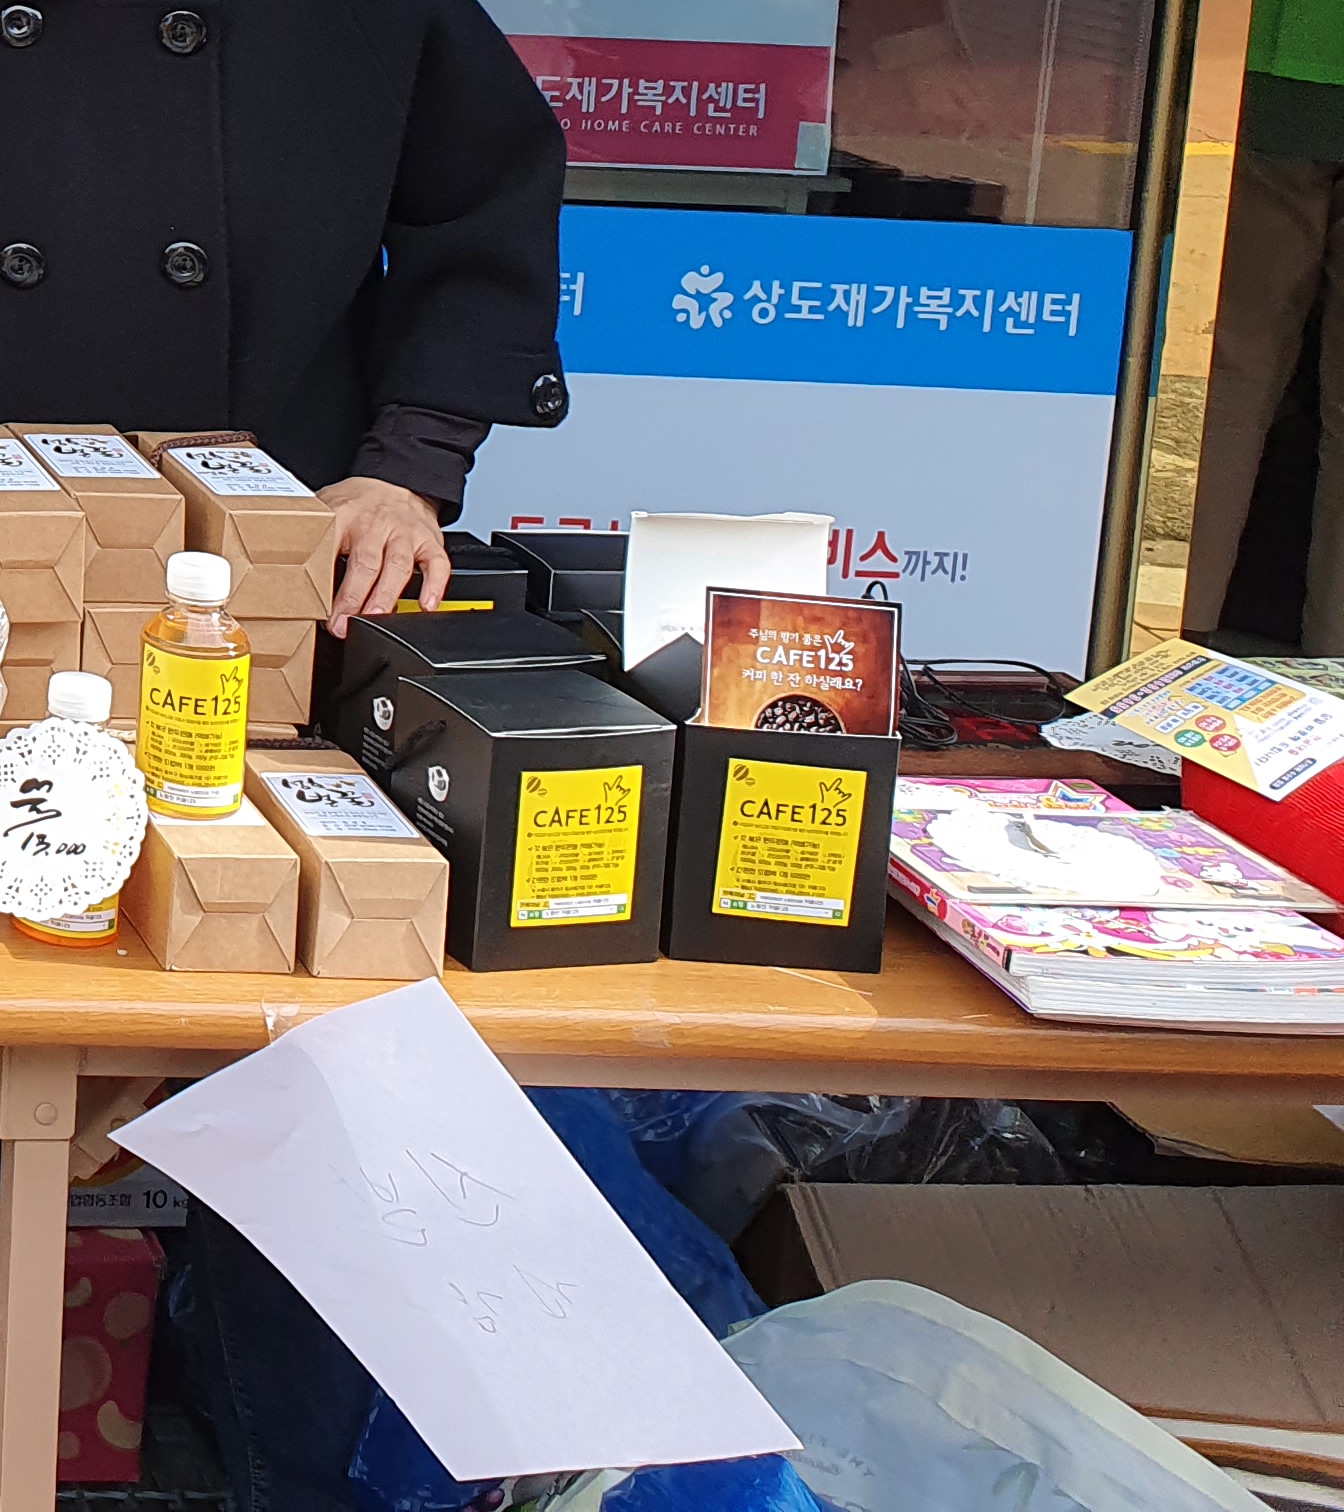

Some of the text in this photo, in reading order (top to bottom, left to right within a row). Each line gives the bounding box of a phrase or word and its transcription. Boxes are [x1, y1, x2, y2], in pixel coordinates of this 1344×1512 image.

[581, 118, 760, 138] HOME CARE CENTER
[743, 278, 1082, 338] 상도재가복지센터
[756, 645, 853, 672] CAFE125
[742, 668, 862, 691] 커피 한 잔 하실래요?
[534, 804, 627, 827] CAFE125
[740, 798, 847, 826] CAFE125
[143, 1190, 168, 1208] 10
